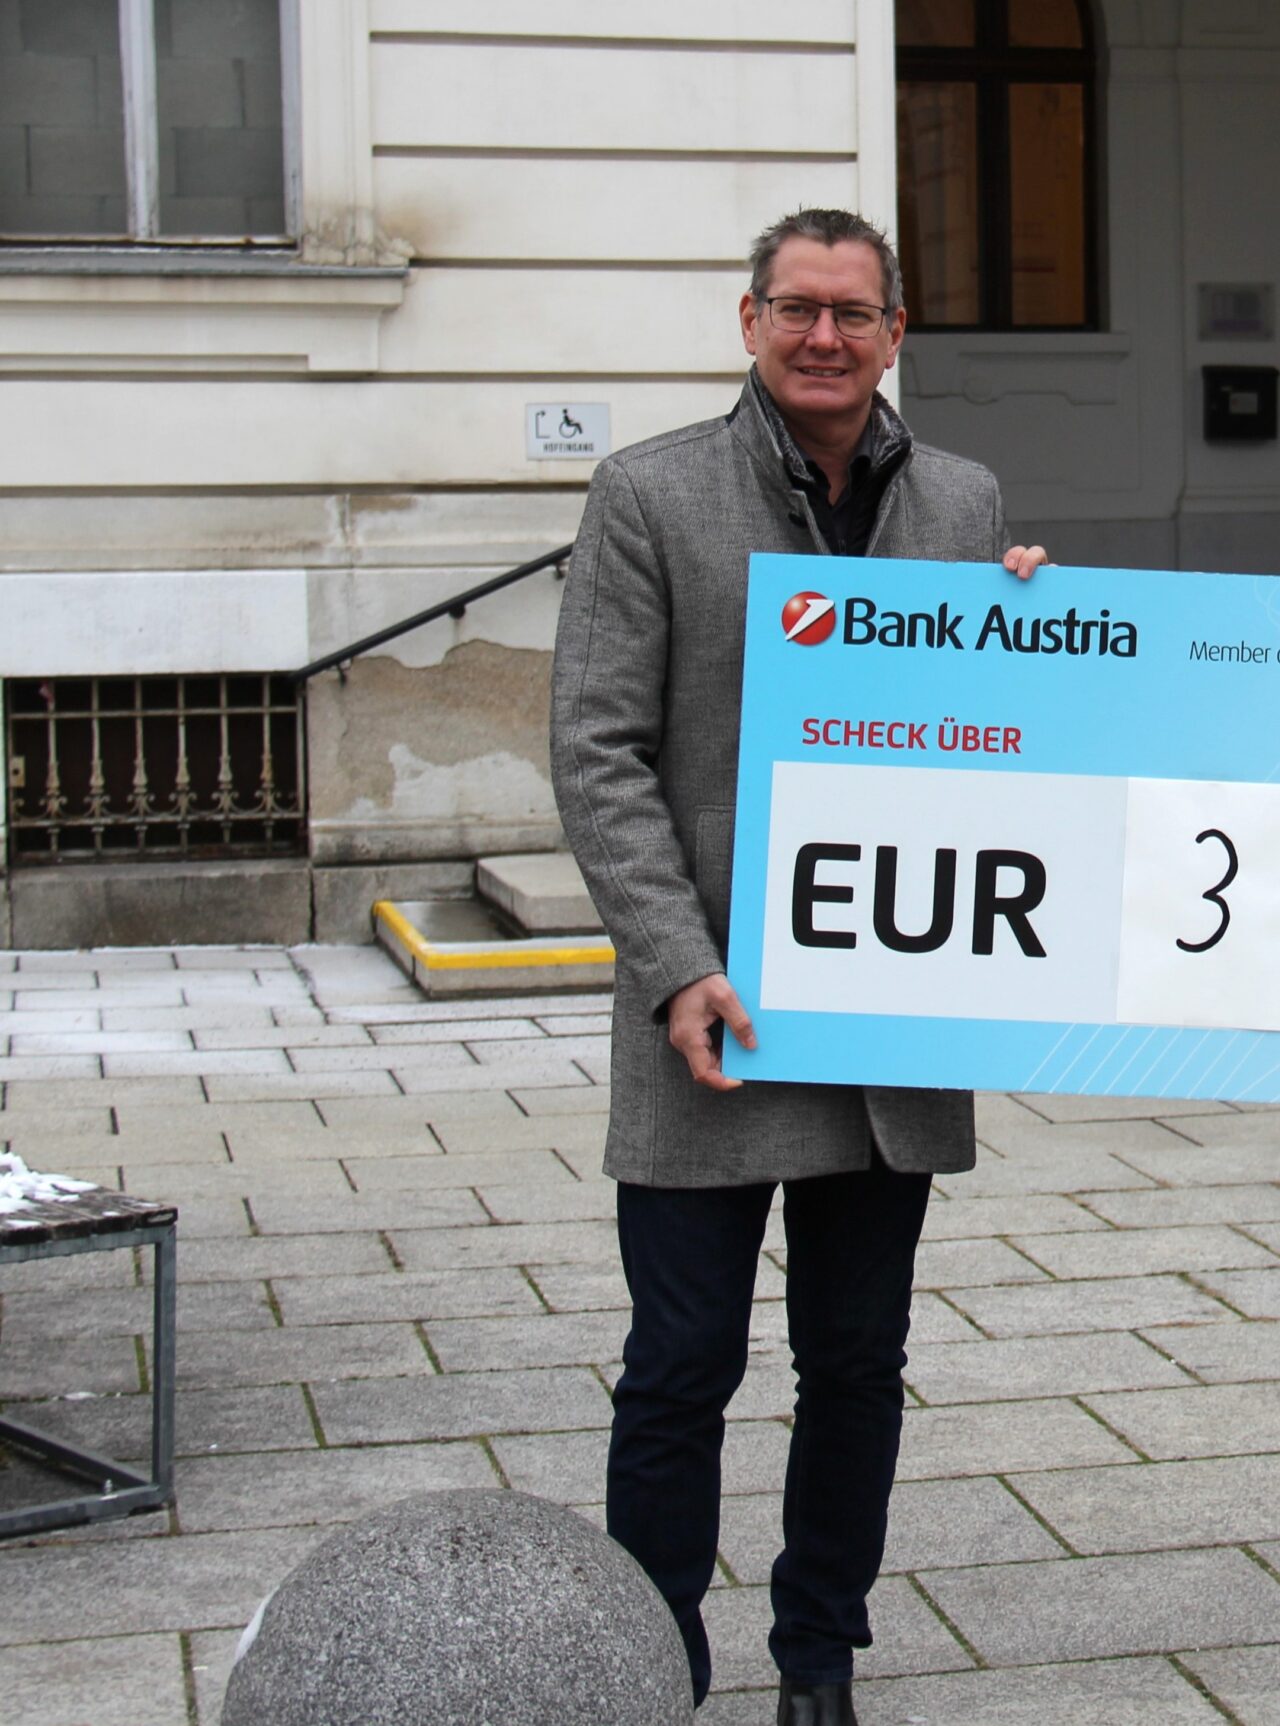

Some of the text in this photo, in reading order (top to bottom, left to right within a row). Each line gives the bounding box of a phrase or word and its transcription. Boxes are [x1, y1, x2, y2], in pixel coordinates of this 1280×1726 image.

[843, 597, 1138, 658] Bank Austria
[1189, 640, 1272, 664] Member
[802, 716, 1022, 754] SCHECK ÜBER
[791, 842, 1047, 958] EUR
